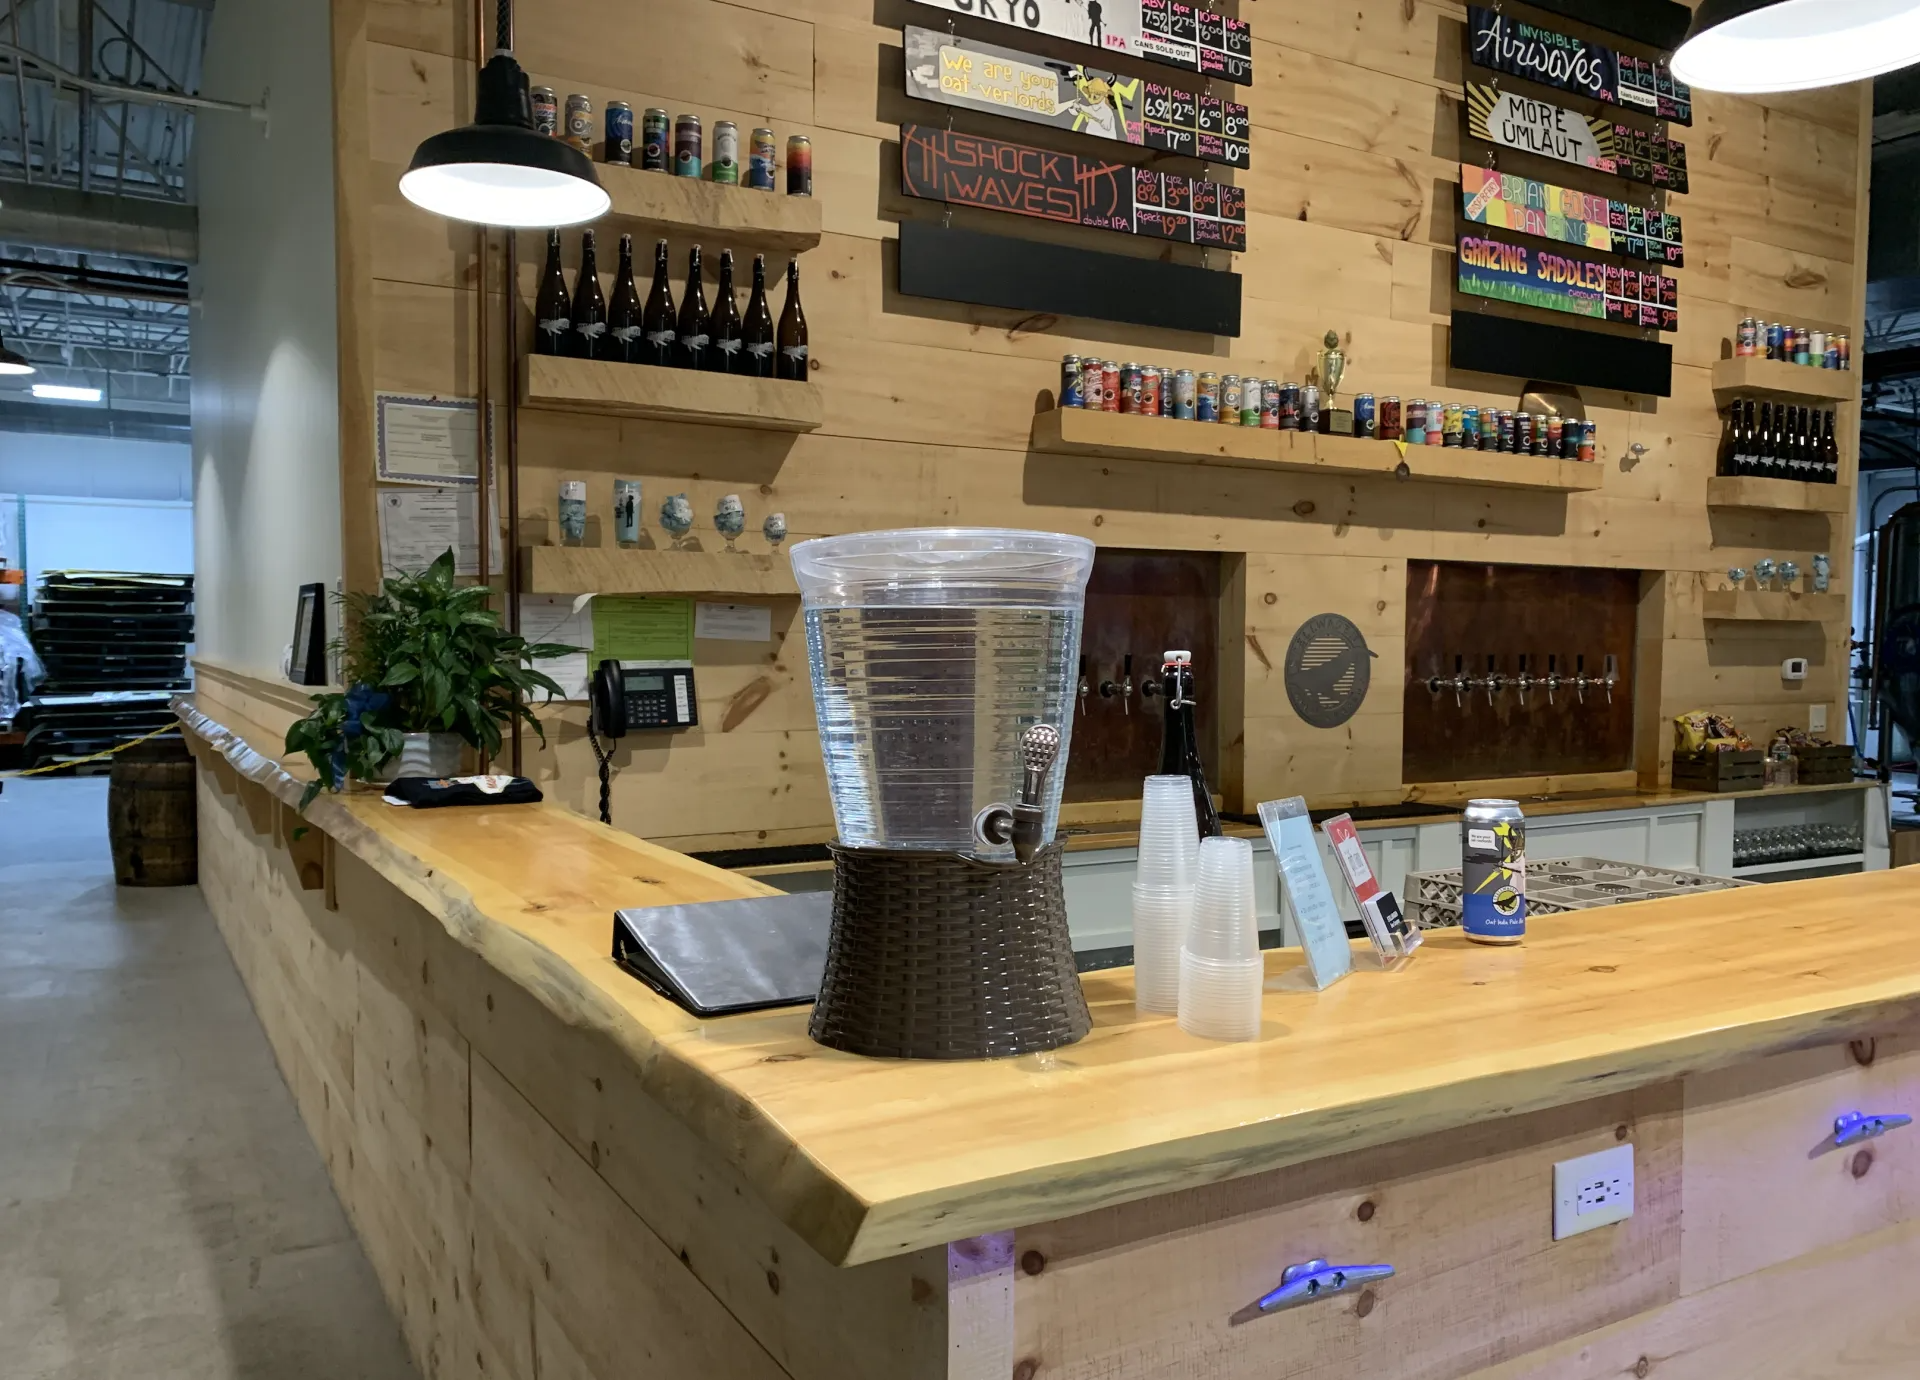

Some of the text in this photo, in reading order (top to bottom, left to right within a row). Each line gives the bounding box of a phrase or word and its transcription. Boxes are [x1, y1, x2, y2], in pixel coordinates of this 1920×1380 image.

[1106, 34, 1126, 49] IPA
[1134, 39, 1154, 50] CANS
[1156, 45, 1174, 55] SOLD
[1176, 48, 1190, 58] OUT
[1519, 23, 1580, 51] INVISIBLE
[1476, 15, 1602, 91] Airwaves
[941, 51, 1058, 91] We are your
[1145, 83, 1168, 96] ABV
[1600, 88, 1614, 102] IPA
[1509, 96, 1567, 133] MÖRË
[1502, 119, 1582, 162] ÜMLÄUT
[1615, 125, 1630, 136] ABV
[954, 139, 1062, 183] SHOCK
[1136, 169, 1159, 184] ABV
[951, 170, 1073, 218] WAVES
[1137, 184, 1160, 203] 8%
[1467, 180, 1500, 218] RASPBERRY
[1501, 174, 1603, 223] BRIAN GOSE
[1609, 201, 1625, 212] ABV
[1083, 213, 1131, 231] double IPA
[1513, 207, 1590, 243] DANCING
[1460, 237, 1604, 292] GRAZING SADDLES
[1606, 266, 1621, 279] ABV
[1568, 289, 1601, 300] CHOCOLATE
